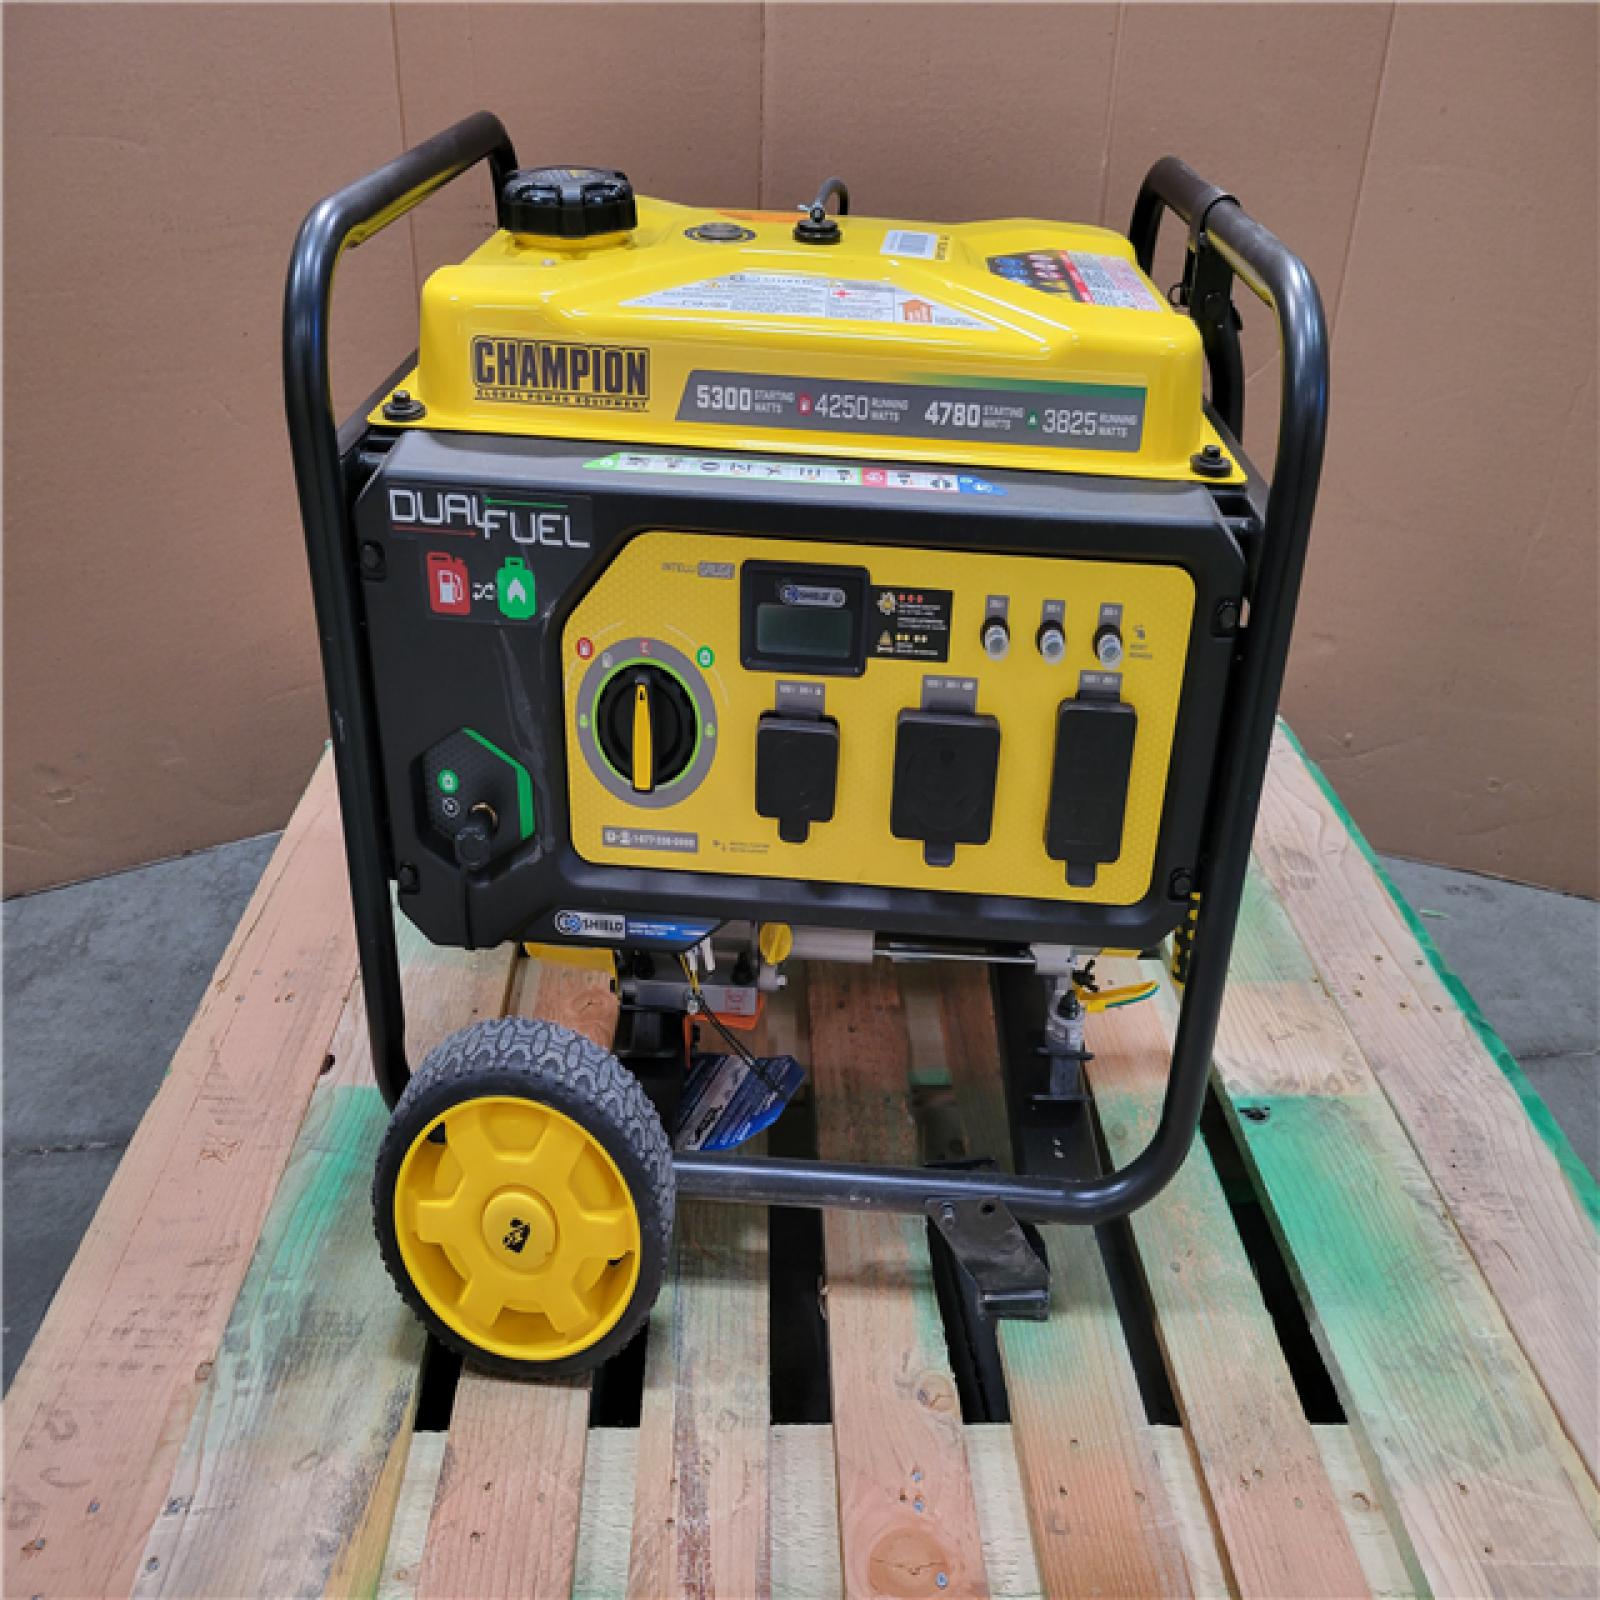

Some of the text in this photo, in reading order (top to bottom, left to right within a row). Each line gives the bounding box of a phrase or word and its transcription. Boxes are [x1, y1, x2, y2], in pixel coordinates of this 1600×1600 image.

[474, 340, 648, 396] CHAMPION
[696, 384, 751, 411] 5300
[814, 394, 869, 421] 4250
[924, 401, 982, 428] 4780
[1041, 408, 1099, 437] 3825
[388, 488, 486, 527] DUAL
[482, 508, 591, 549] FUEL
